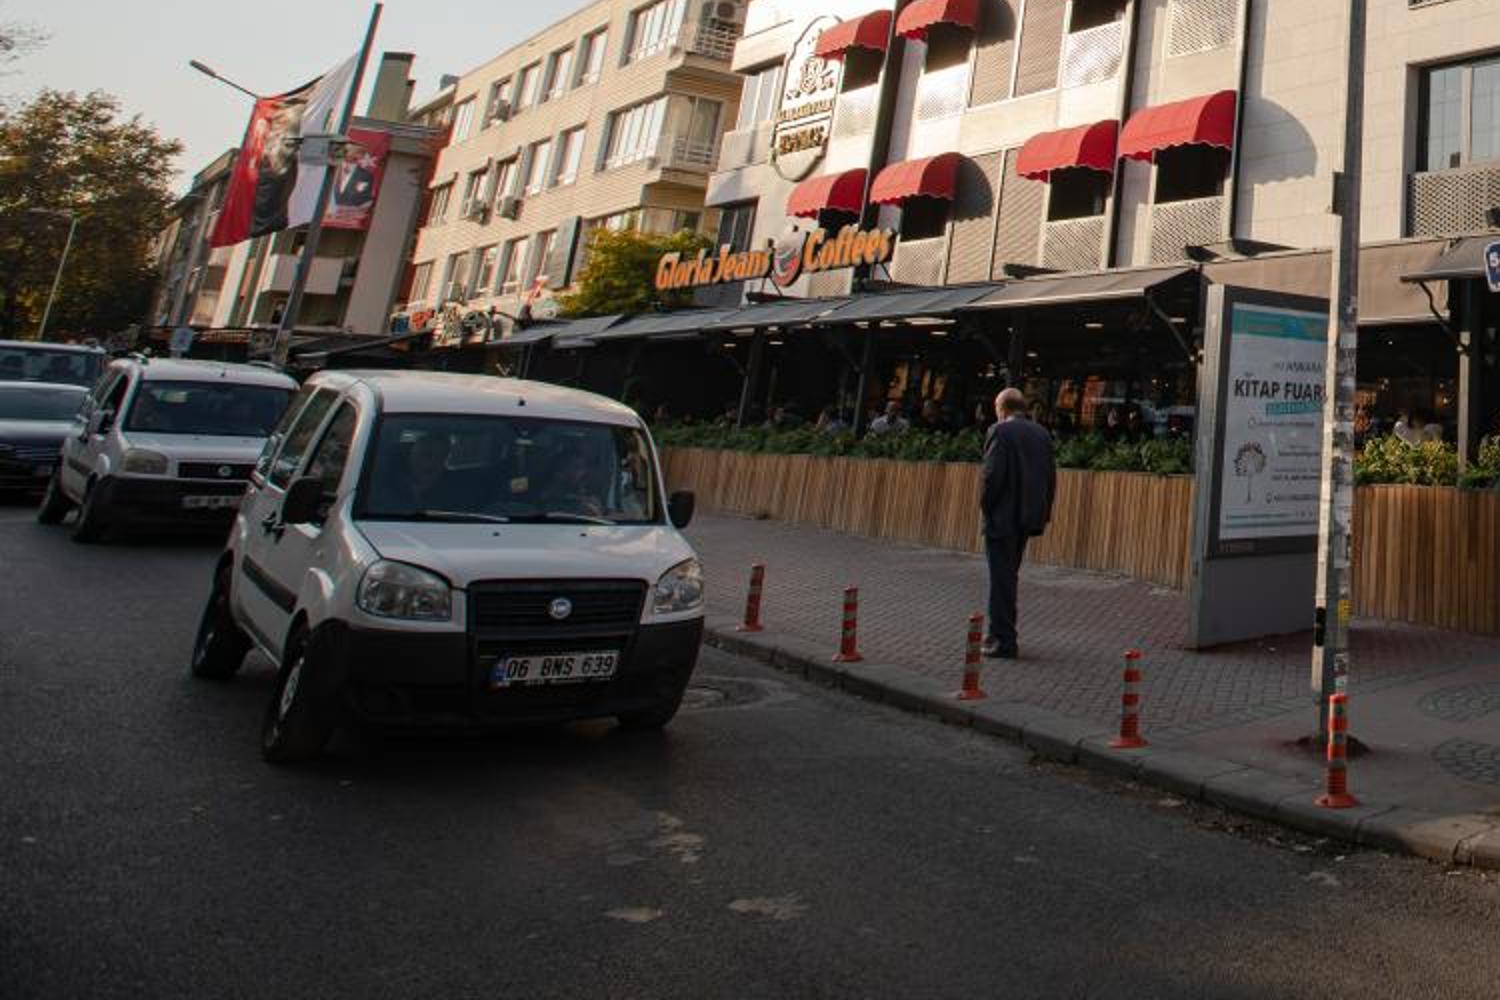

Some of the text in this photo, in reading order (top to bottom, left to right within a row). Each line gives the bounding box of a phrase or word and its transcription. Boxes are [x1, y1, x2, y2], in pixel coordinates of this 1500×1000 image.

[655, 247, 713, 291] Gloria
[506, 659, 530, 679] 06
[581, 654, 615, 675] 639
